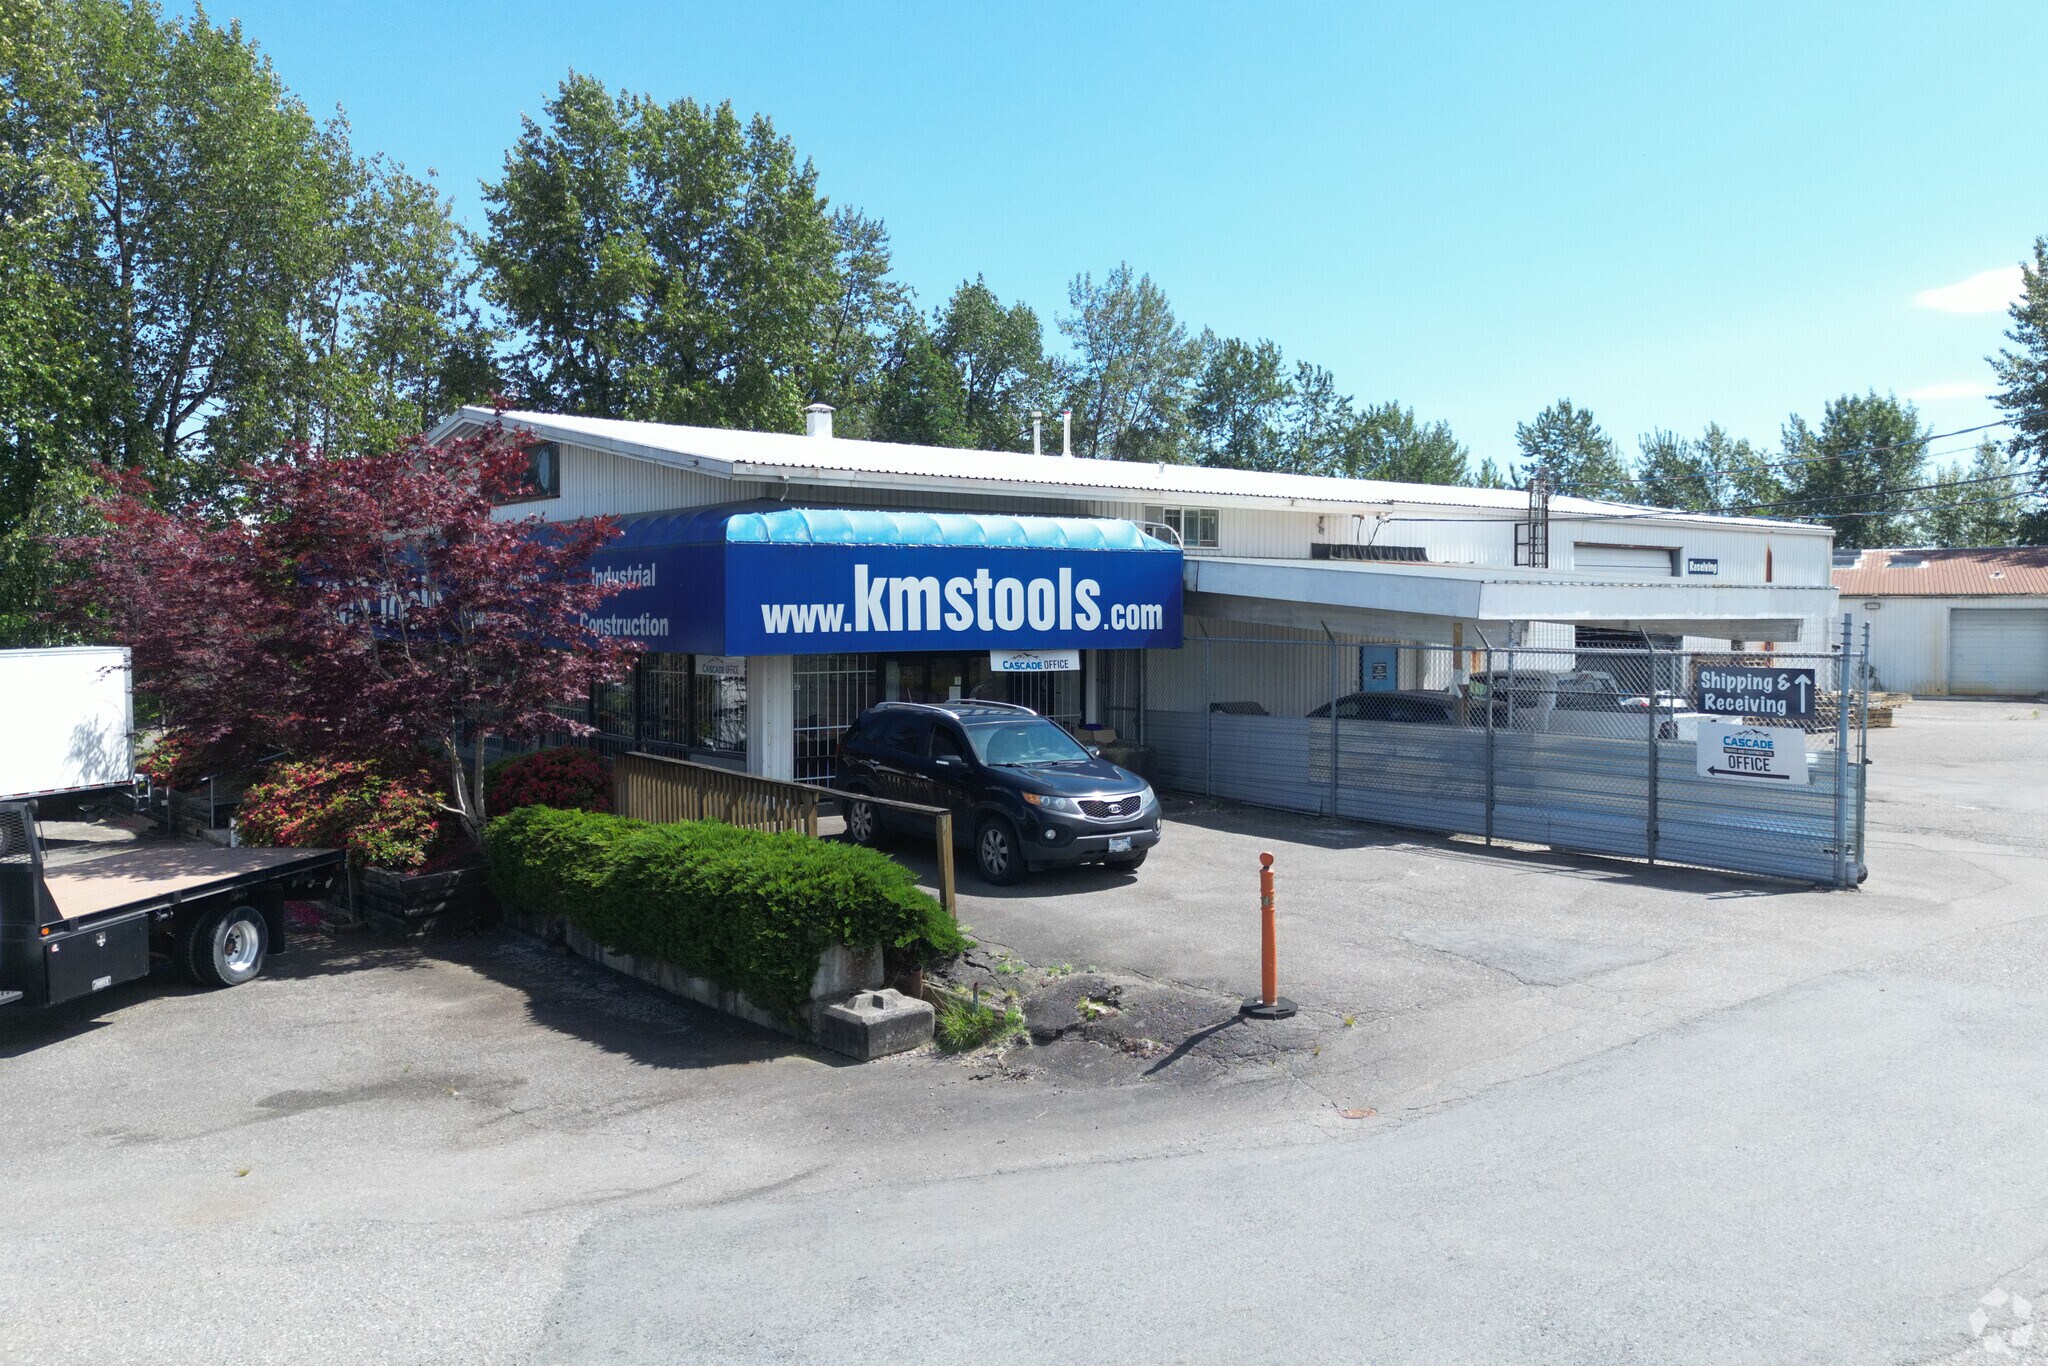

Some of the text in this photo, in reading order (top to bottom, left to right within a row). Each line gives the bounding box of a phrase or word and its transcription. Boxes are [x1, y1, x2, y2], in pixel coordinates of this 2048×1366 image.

[591, 563, 656, 587] Industrial
[1689, 561, 1717, 574] Receiving
[760, 563, 1163, 634] www.kmstools.com
[702, 664, 739, 674] CASCADE OFFICE
[1002, 659, 1069, 670] CASCADE OFFICE
[1701, 670, 1791, 693] Shipping &
[1704, 693, 1787, 717] Receiving
[1723, 735, 1774, 750] CASCADE
[1728, 755, 1771, 772] OFFICE
